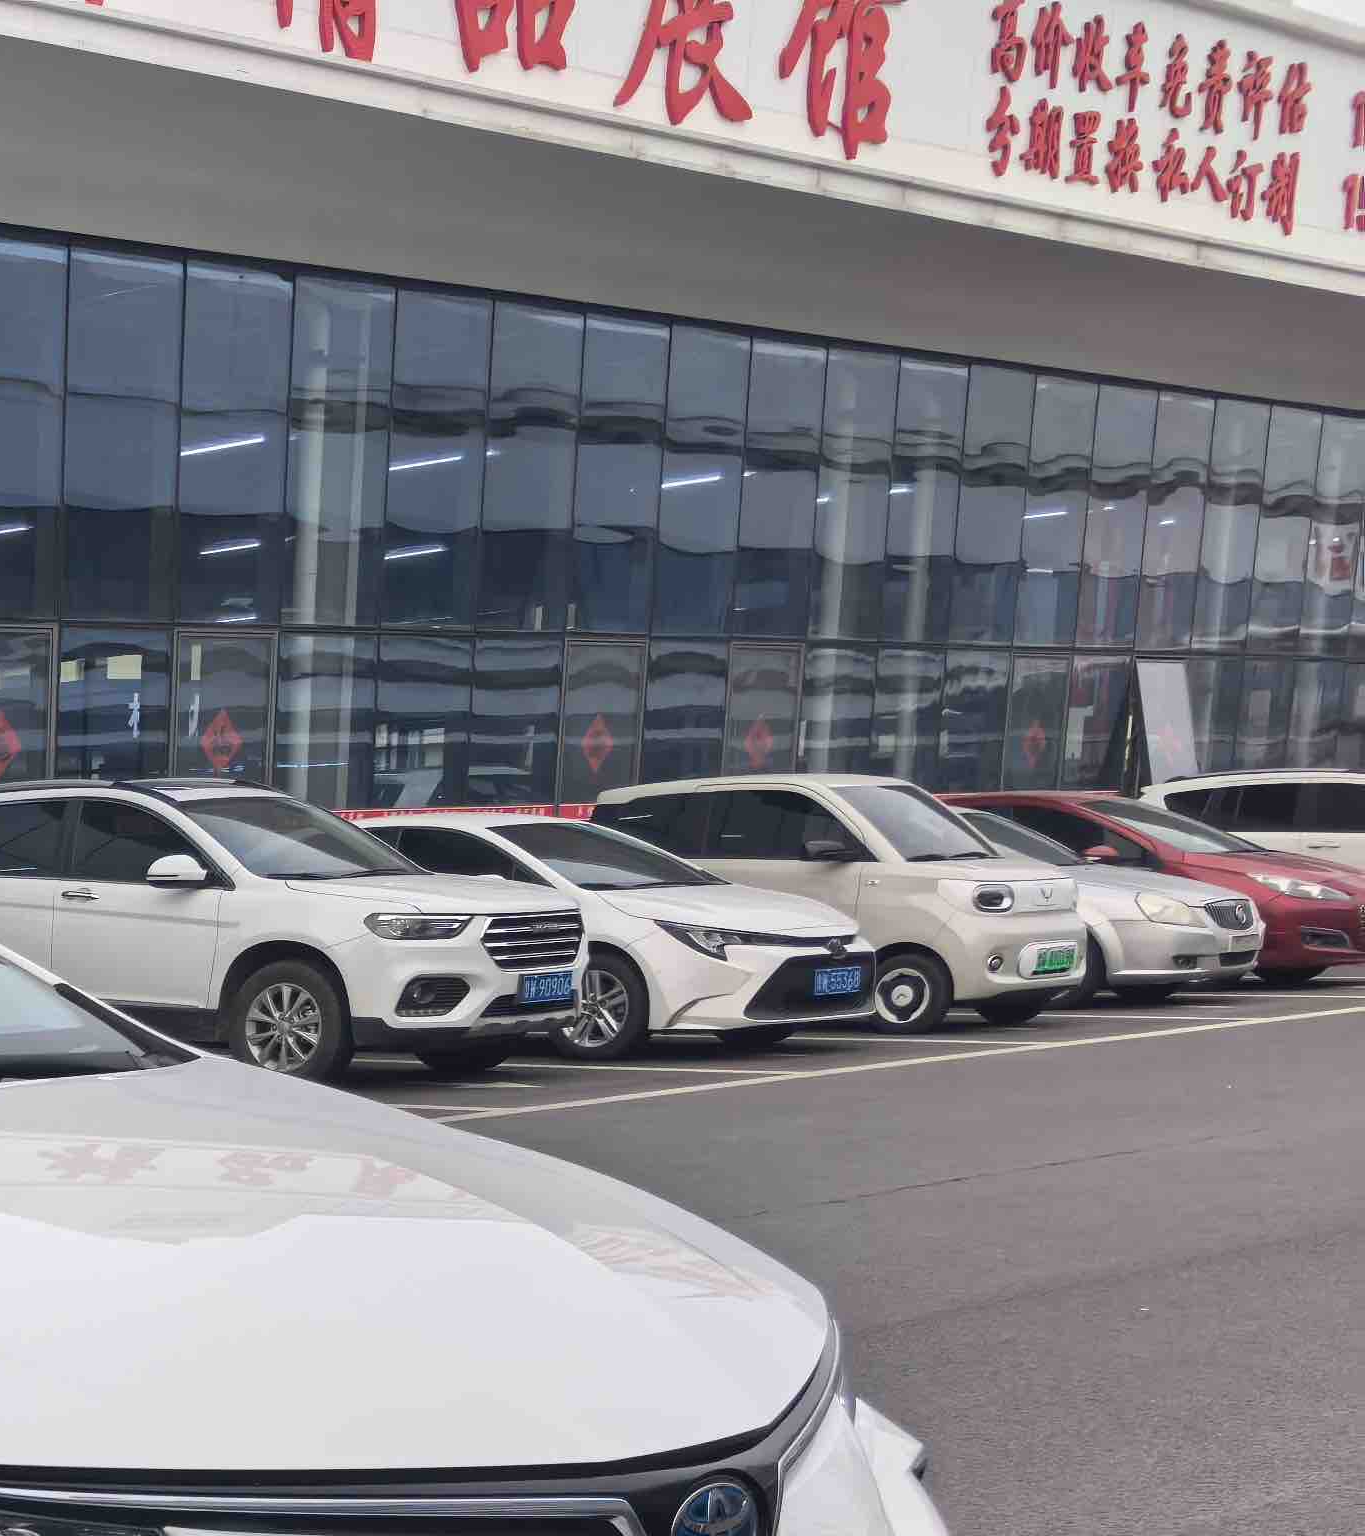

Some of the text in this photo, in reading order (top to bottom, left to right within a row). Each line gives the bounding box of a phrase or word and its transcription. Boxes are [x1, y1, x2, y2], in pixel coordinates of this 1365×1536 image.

[990, 0, 1312, 141] 高价收车免费评估
[985, 86, 1302, 237] 分期置换私人订制
